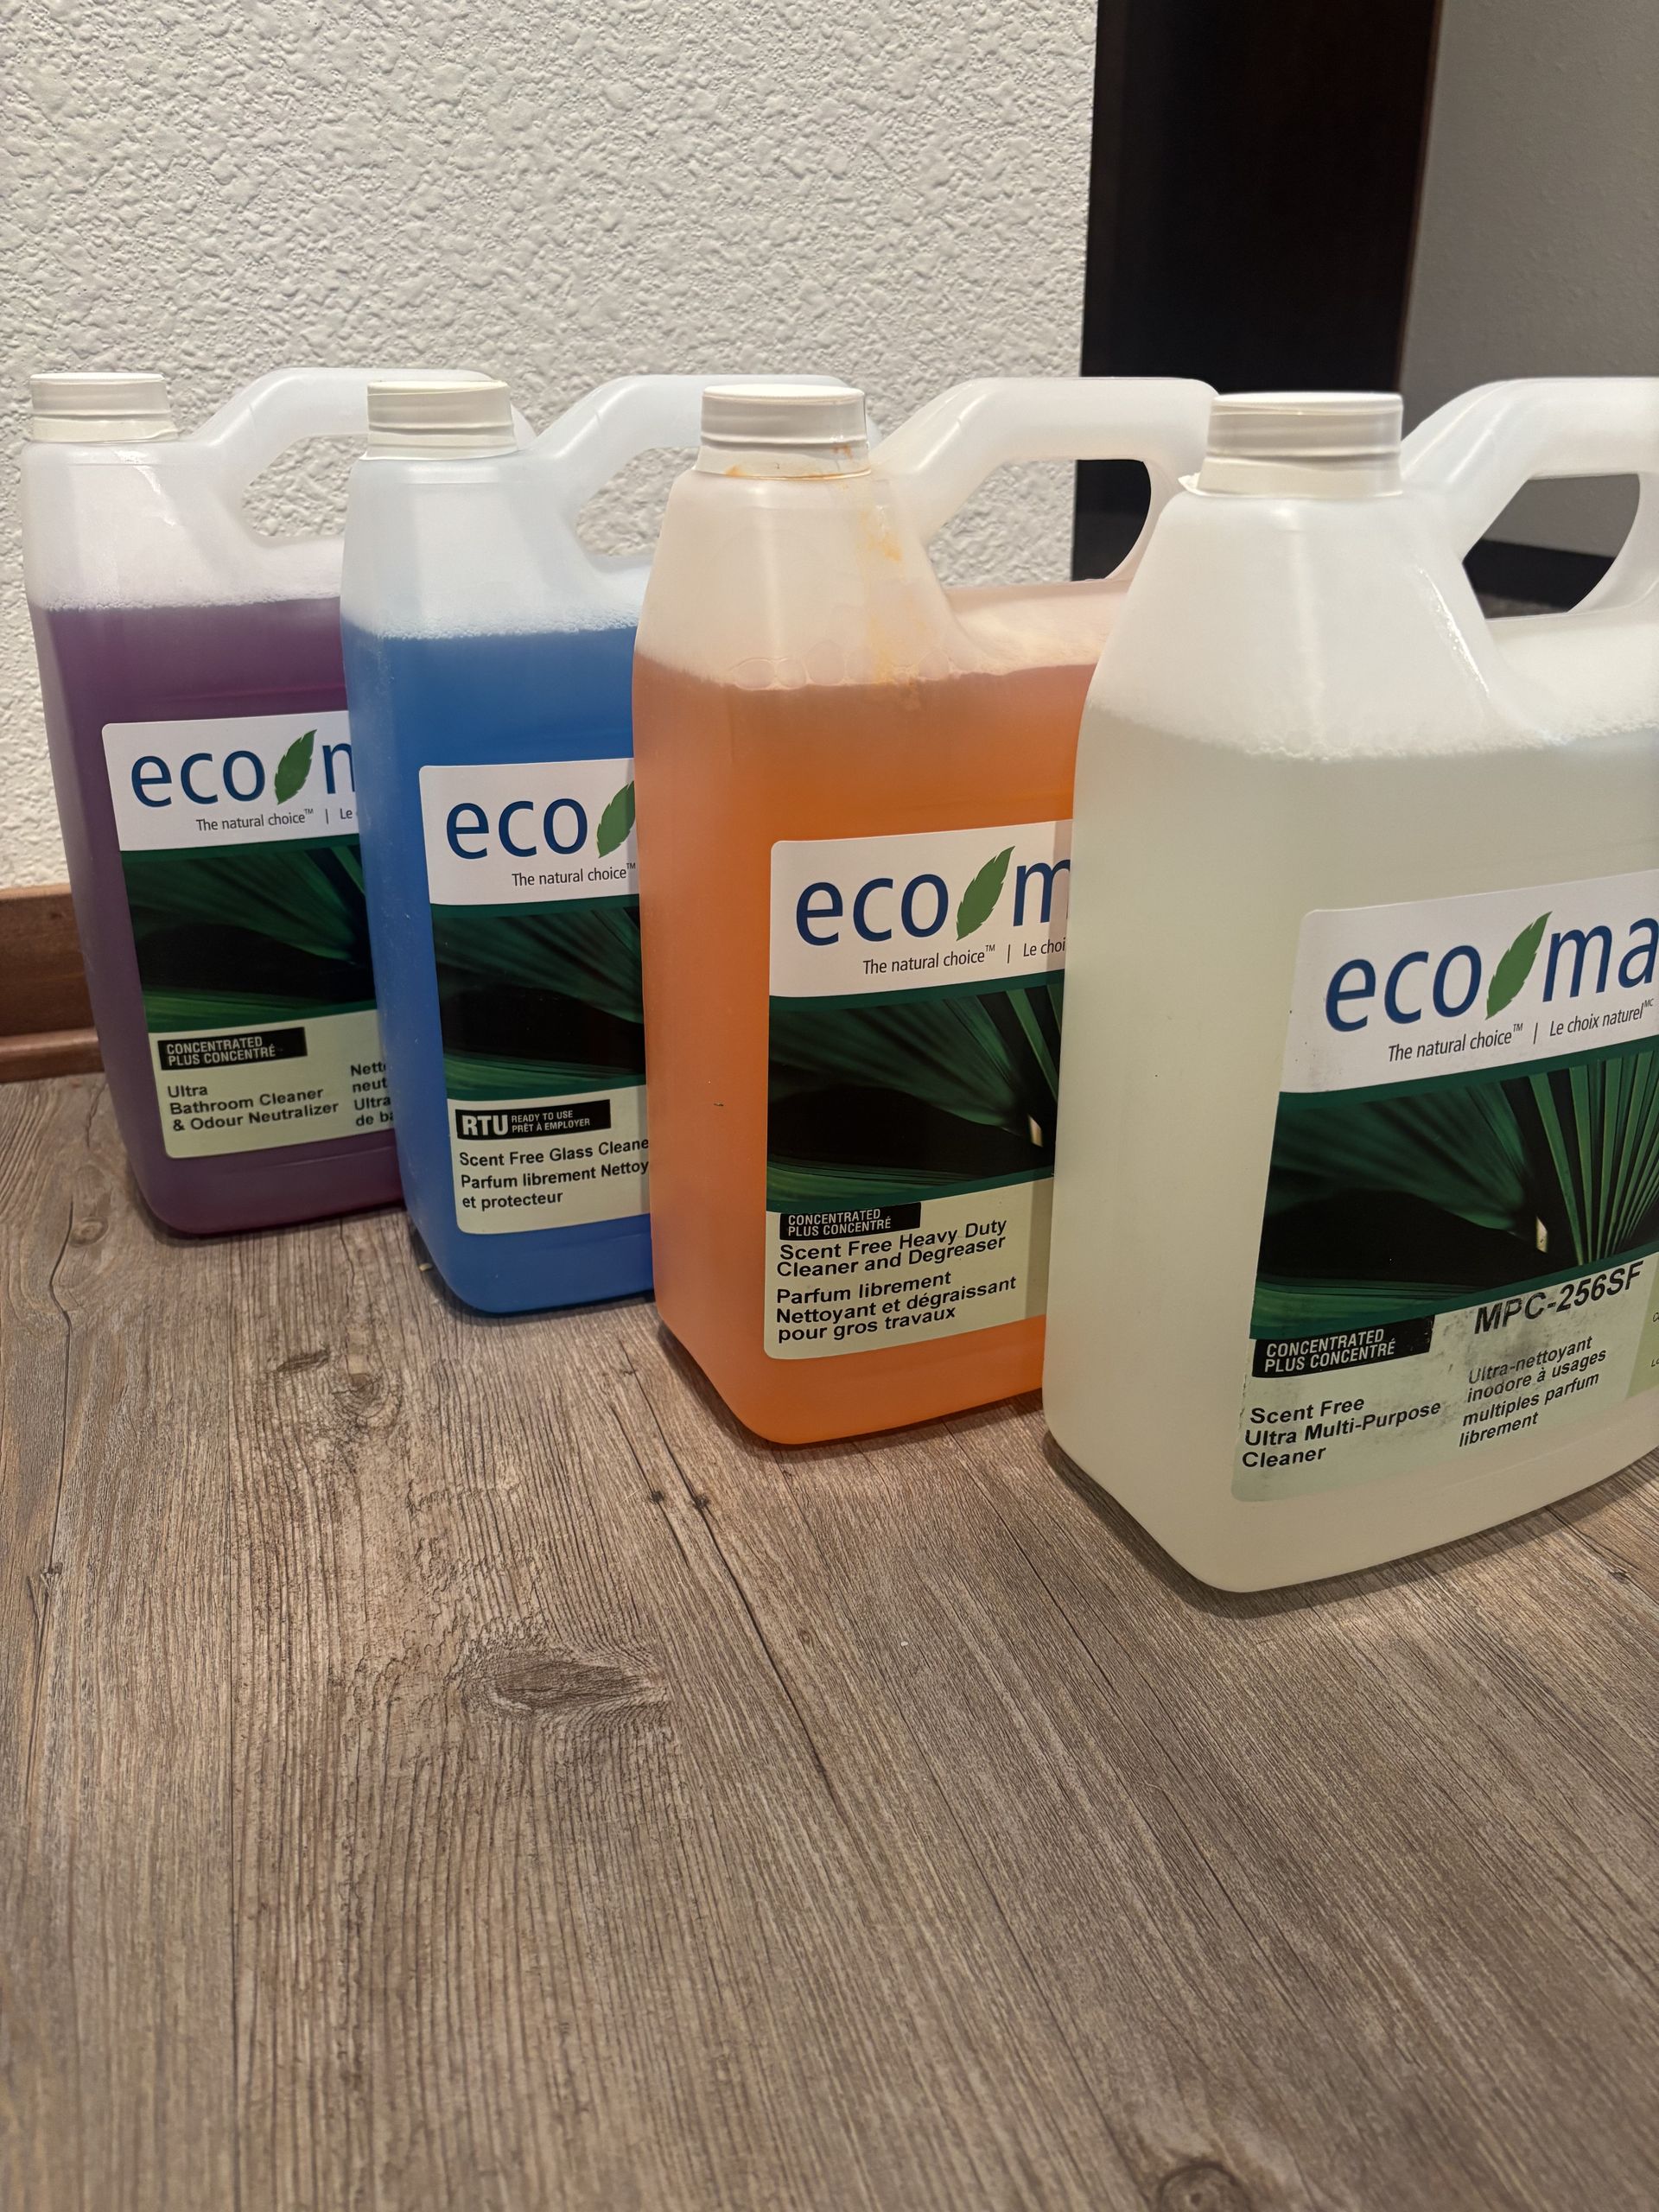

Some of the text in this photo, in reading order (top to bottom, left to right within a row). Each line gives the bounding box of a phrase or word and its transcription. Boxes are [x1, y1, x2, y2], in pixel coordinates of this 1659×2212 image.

[195, 818, 219, 831] The
[221, 815, 264, 830] natural
[340, 808, 353, 820] Le
[446, 798, 588, 860] eco
[512, 873, 535, 887] The
[538, 868, 583, 885] natural
[862, 959, 887, 975] The
[891, 952, 939, 973] natural
[1023, 942, 1037, 957] Le
[166, 1036, 263, 1055] CONCENTRATED
[1388, 1044, 1413, 1063] The
[1416, 1033, 1466, 1059] natural
[1549, 1020, 1564, 1037] Le
[1567, 1012, 1599, 1034] choix
[168, 1044, 276, 1066] PLUS CONCENTRÉ
[168, 1085, 208, 1098] Ultra
[169, 1088, 324, 1115] Bathroom Cleaner
[354, 1096, 391, 1110] Ultra
[172, 1103, 340, 1132] & Odour Neutralizer
[356, 1115, 374, 1127] de
[461, 1114, 509, 1136] RTU
[512, 1109, 574, 1123] READY TO USE
[512, 1118, 591, 1134] PRÊT À EMPLOYER
[459, 1151, 505, 1166] Scent
[509, 1150, 544, 1165] Free
[549, 1146, 594, 1161] Glass
[461, 1173, 518, 1189] Parfum
[523, 1166, 596, 1187] librement
[462, 1191, 563, 1212] et protecteur
[788, 1209, 881, 1226] CONCENTRATED
[788, 1216, 892, 1236] PLUS CONCENTRÉ
[779, 1219, 1007, 1261] Scent Free Heavy Duty
[777, 1235, 1007, 1278] Cleaner and Degreaser
[776, 1275, 1017, 1325] Nettoyant et dégraissant
[777, 1270, 951, 1305] Parfum librement
[1474, 1260, 1644, 1335] MPC-256SF
[779, 1307, 956, 1344] pour gros travaux
[1264, 1338, 1396, 1373] PLUS CONCENTRÉ
[1266, 1328, 1385, 1358] CONCENTRATED
[1468, 1336, 1593, 1384] Ultra-nettoyant
[1467, 1349, 1607, 1403] inodore à usages
[1249, 1398, 1365, 1424] Scent Free
[1462, 1373, 1599, 1427] multiples parfum
[1244, 1402, 1441, 1446] Ultra Multi-Purpose
[1459, 1411, 1540, 1447] librement
[1242, 1446, 1327, 1468] Cleaner
